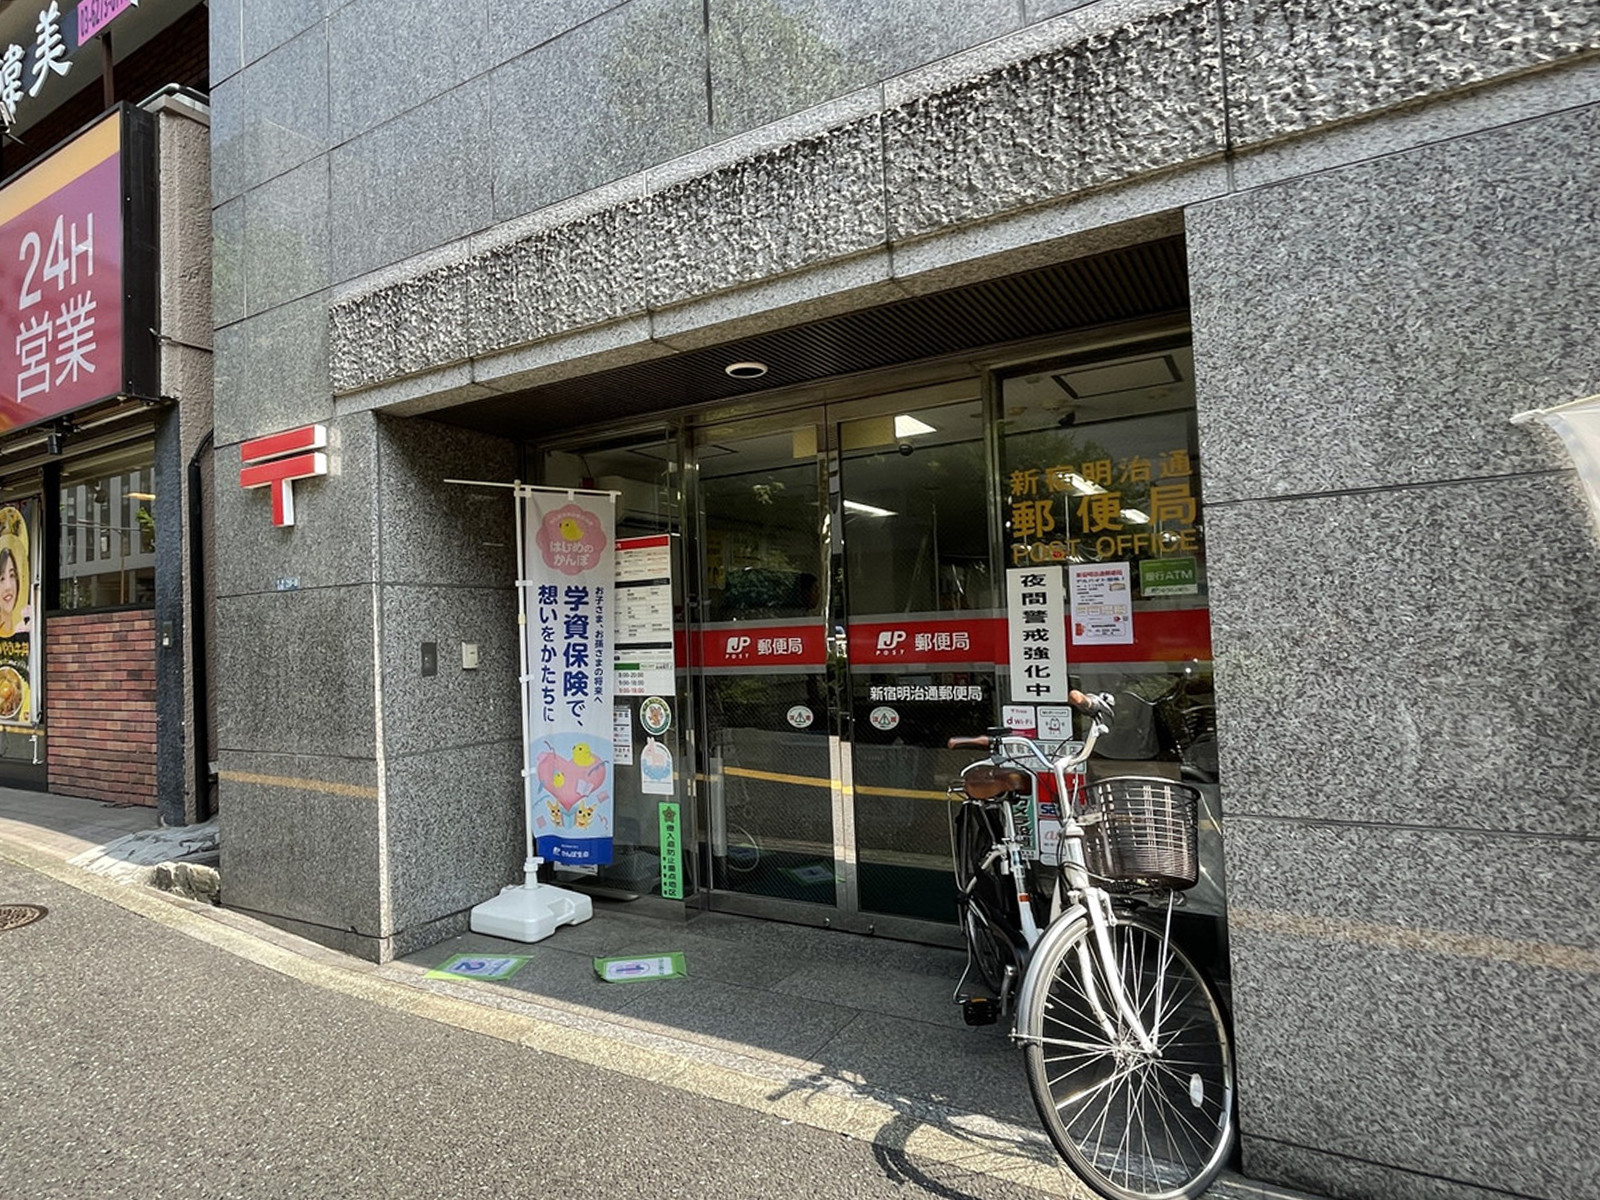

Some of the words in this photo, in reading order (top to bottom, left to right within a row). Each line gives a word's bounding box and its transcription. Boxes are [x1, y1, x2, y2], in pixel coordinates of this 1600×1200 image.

[18, 212, 94, 310] 24H
[16, 290, 97, 403] 営業
[1010, 484, 1198, 538] 郵便局
[549, 541, 594, 553] はじめの
[1010, 538, 1081, 566] POST
[1095, 529, 1200, 558] OFFICE
[538, 584, 558, 722] 想いをかたちに
[563, 585, 590, 727] 学資保険で、
[757, 637, 803, 655] 郵便局
[914, 632, 970, 651] 郵便局
[1020, 573, 1051, 697] 夜間警戒強化中
[870, 686, 983, 701] 新宿明治通郵便局
